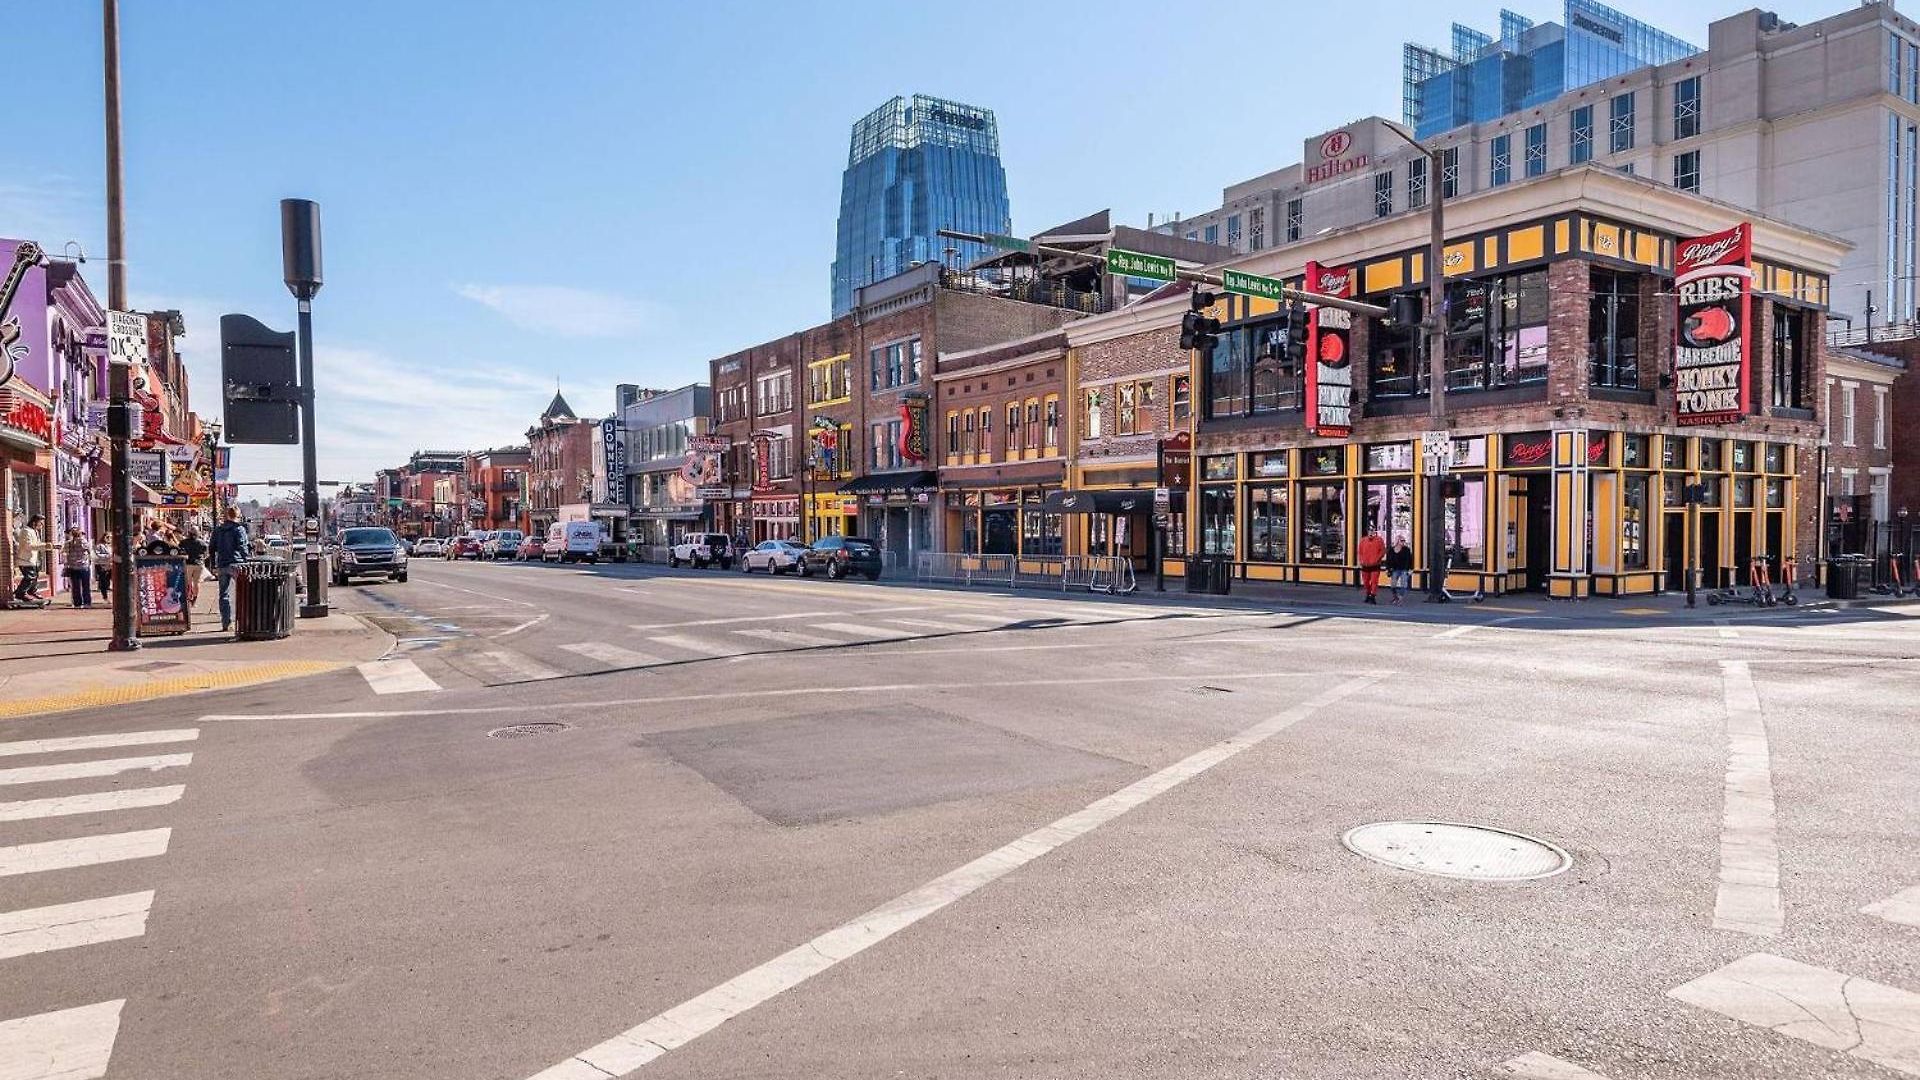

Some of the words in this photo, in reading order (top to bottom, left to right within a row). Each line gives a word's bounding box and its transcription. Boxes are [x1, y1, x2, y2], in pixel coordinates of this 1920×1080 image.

[1308, 155, 1368, 183] Hilton
[1678, 227, 1742, 263] Rippy's
[1130, 257, 1143, 273] John
[1144, 259, 1159, 273] Lewis
[1235, 275, 1247, 289] John
[1247, 277, 1262, 292] Lewis
[1679, 276, 1740, 306] RIBS
[110, 337, 126, 356] OK
[1677, 364, 1740, 392] HONKY
[1677, 388, 1739, 413] TONK
[1679, 413, 1738, 425] NASHVILLE
[605, 422, 617, 500] DOWNTOWN
